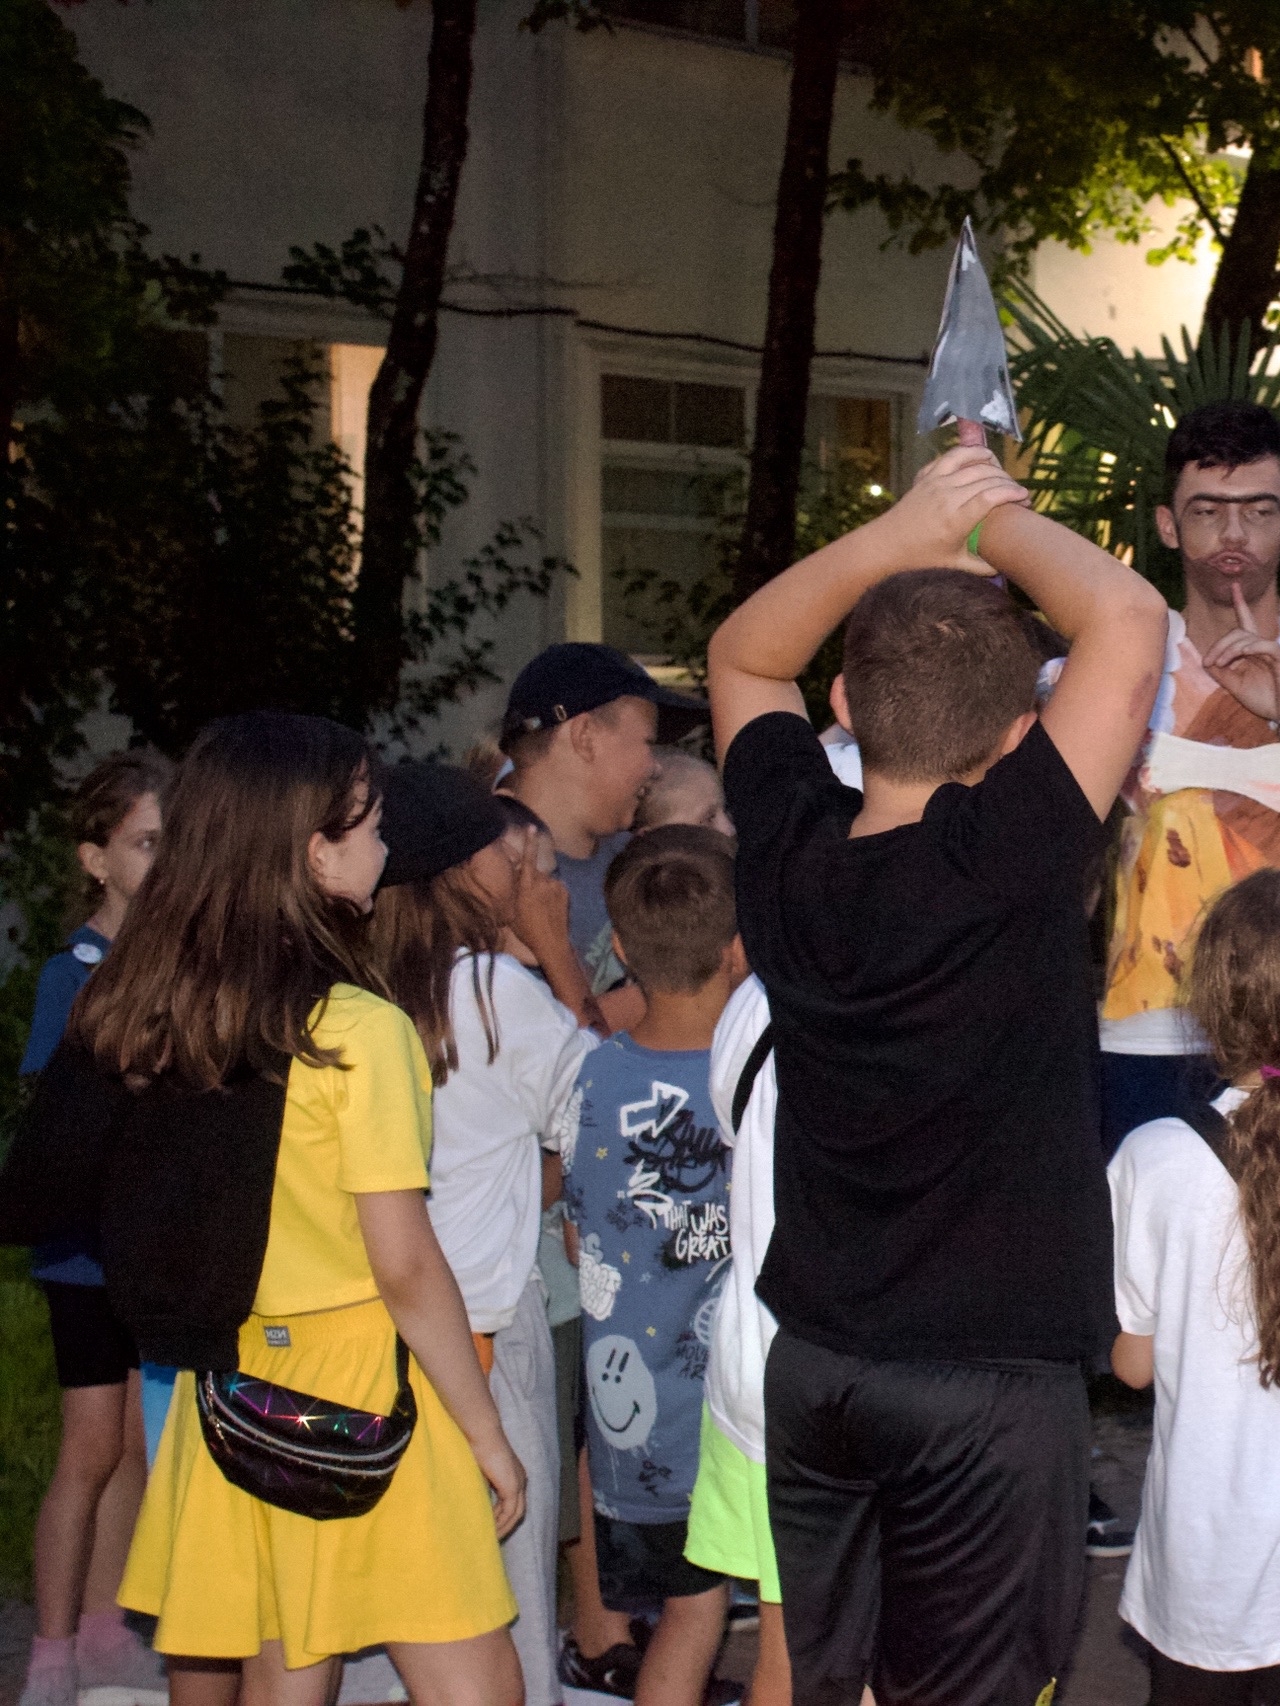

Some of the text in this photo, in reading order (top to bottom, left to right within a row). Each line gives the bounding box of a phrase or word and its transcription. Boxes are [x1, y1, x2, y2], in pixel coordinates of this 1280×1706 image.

[663, 1200, 692, 1231] THAT
[690, 1202, 729, 1236] WAS
[675, 1228, 729, 1264] GREAT
